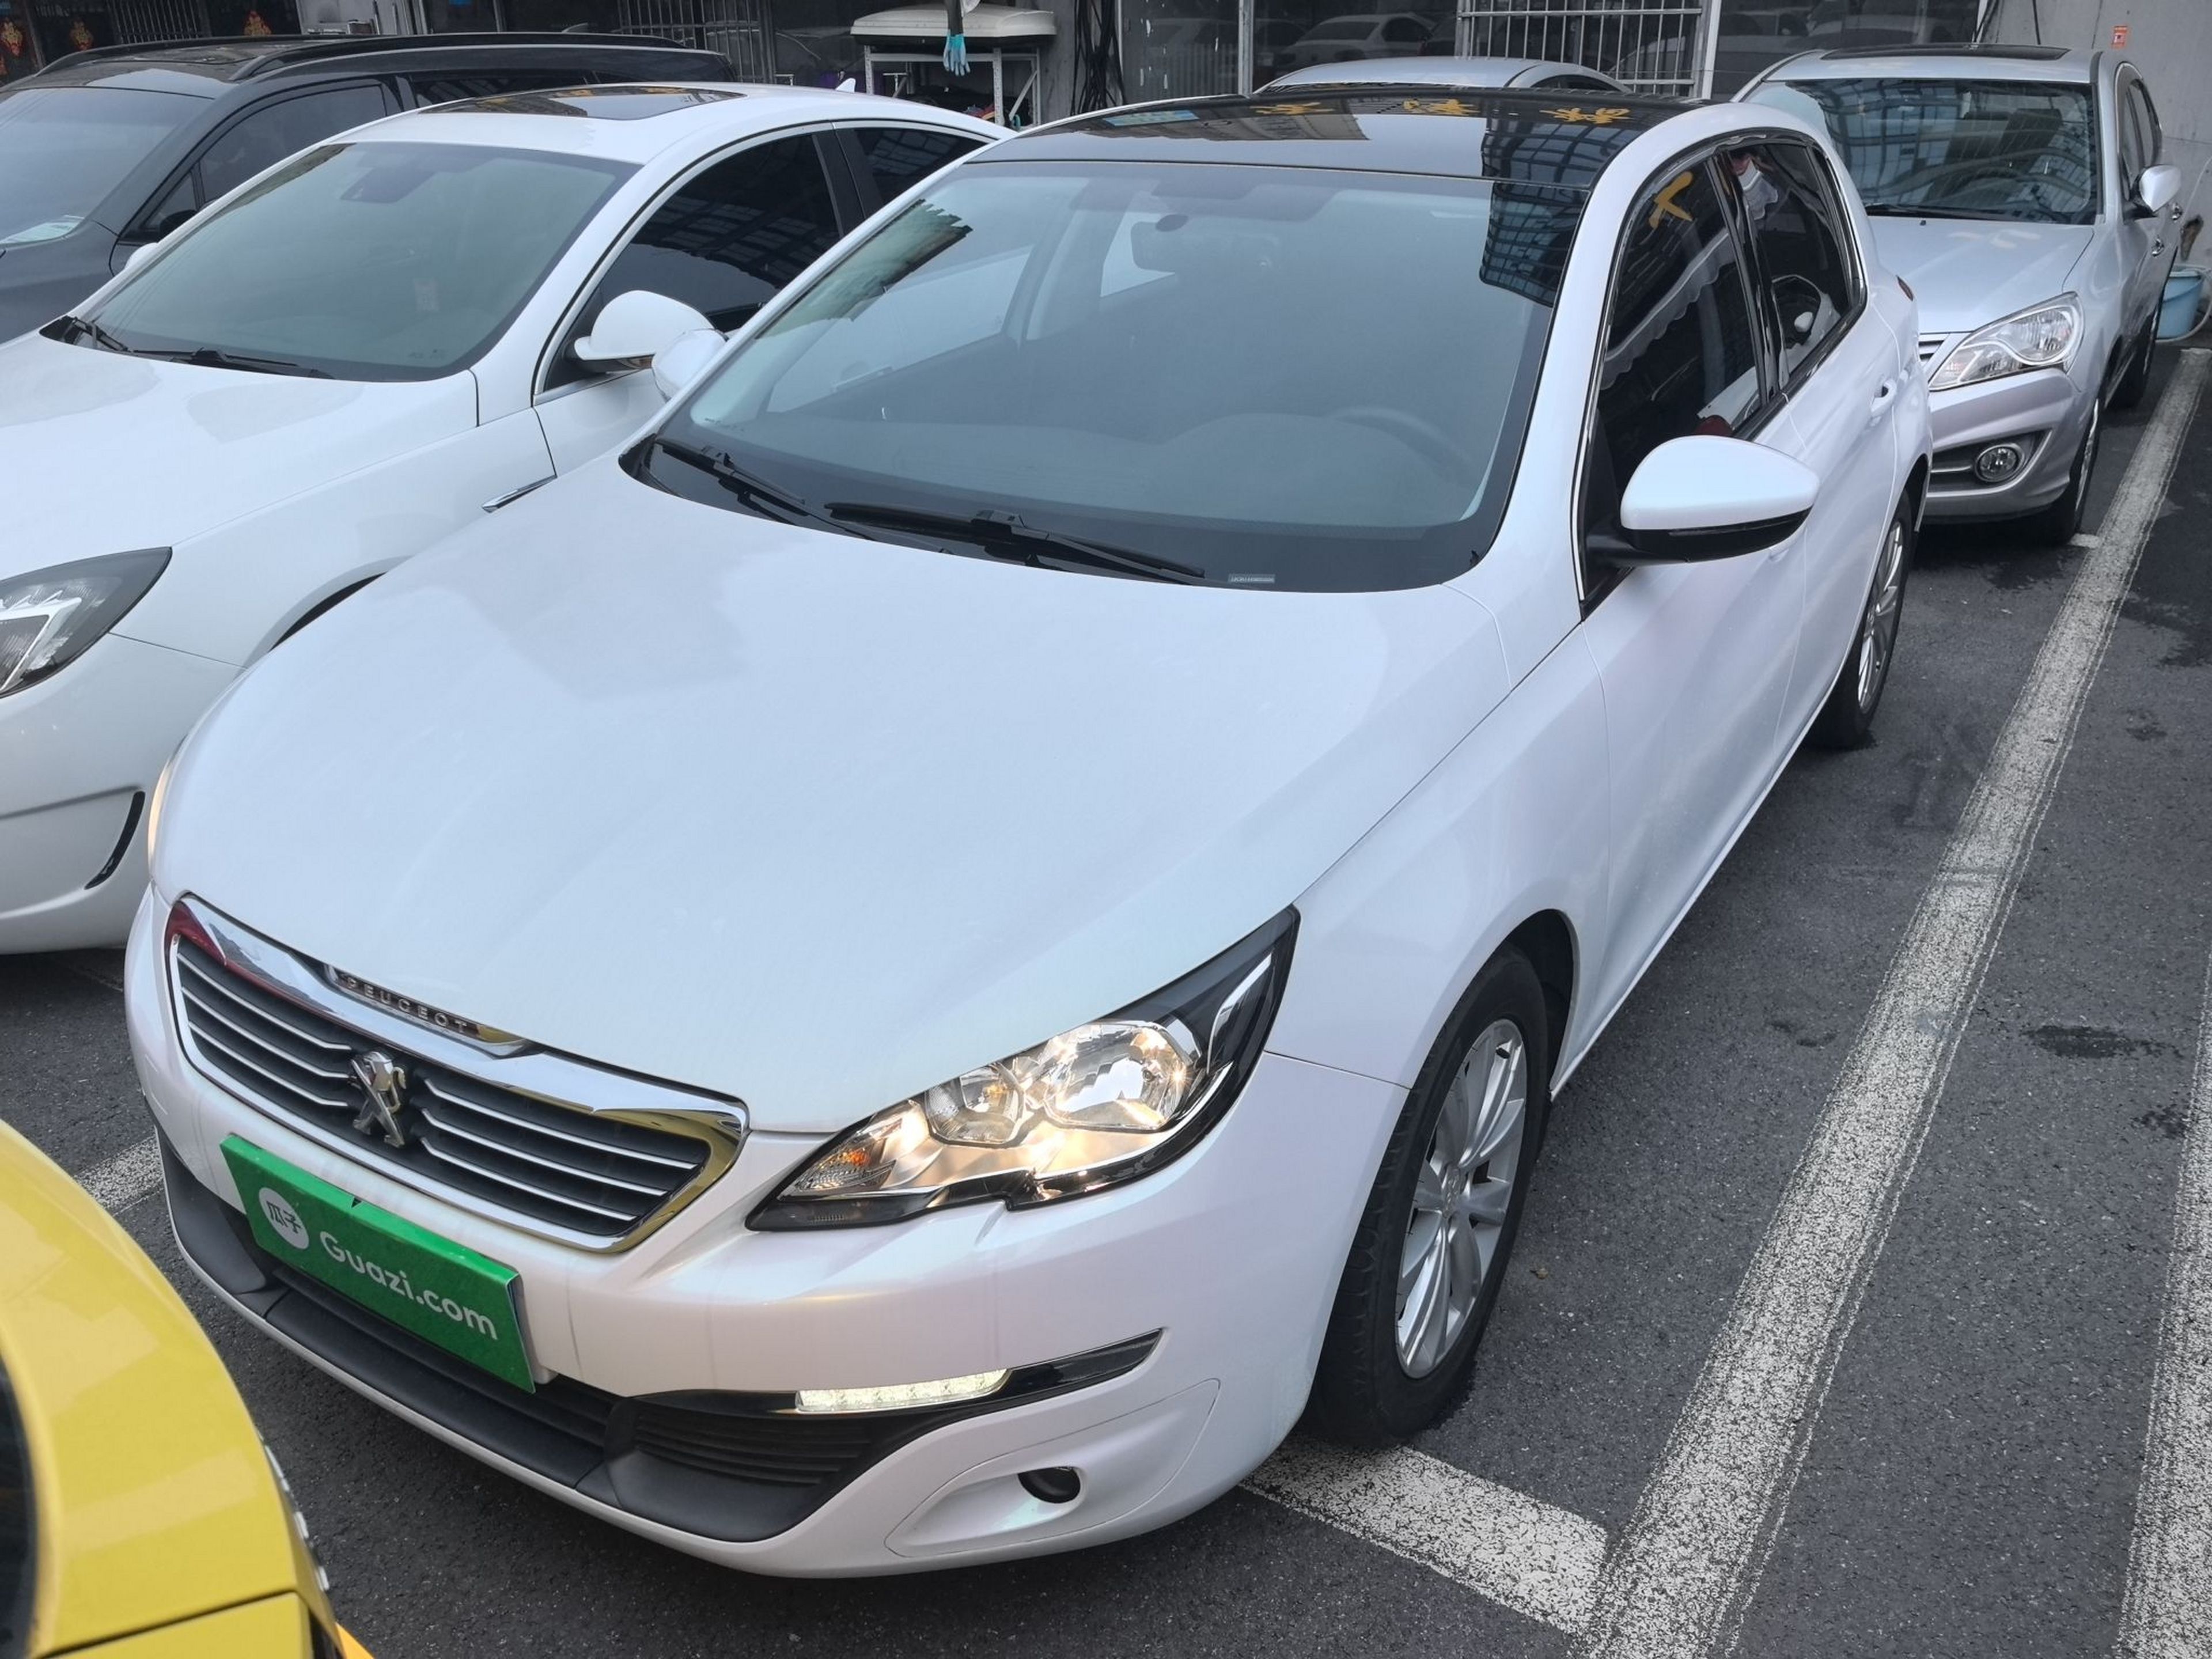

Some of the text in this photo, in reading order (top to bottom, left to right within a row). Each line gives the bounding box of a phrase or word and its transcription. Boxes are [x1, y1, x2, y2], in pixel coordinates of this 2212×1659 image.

[347, 978, 467, 1033] PEUGEOT
[266, 1200, 301, 1234] 瓜子
[320, 1231, 498, 1340] Guazi.com
